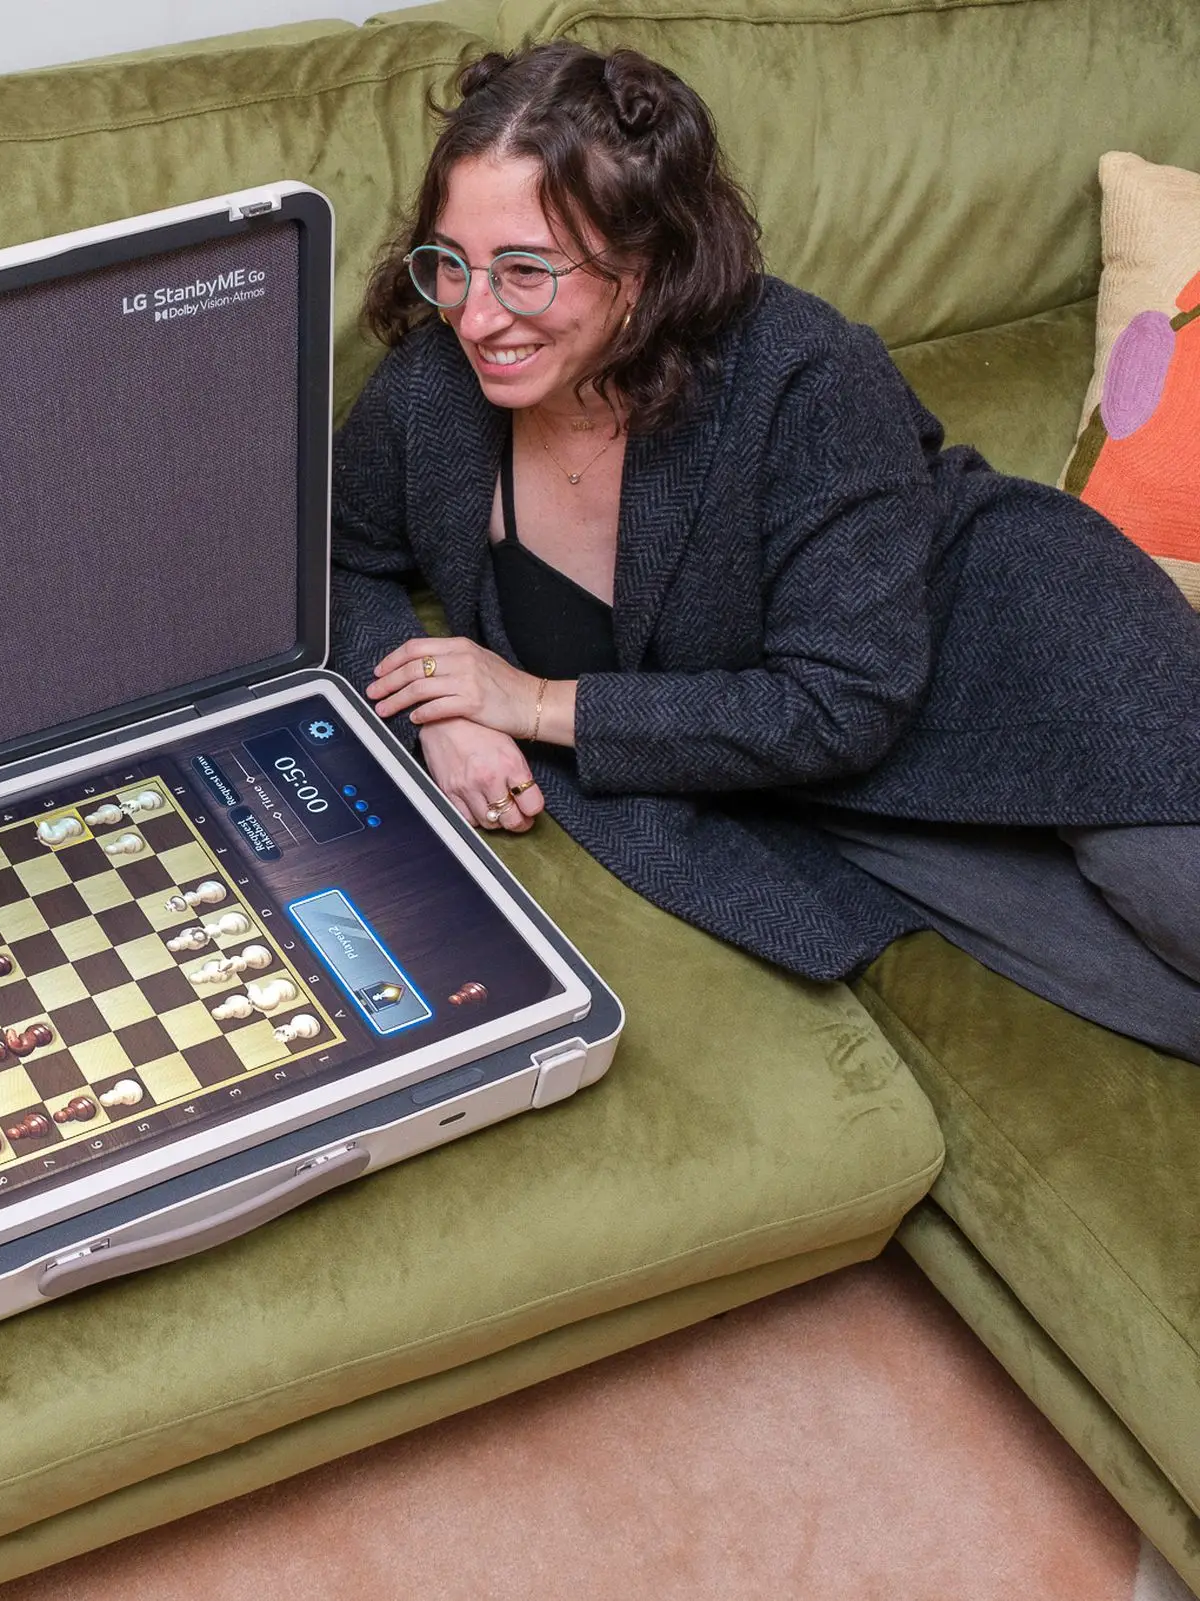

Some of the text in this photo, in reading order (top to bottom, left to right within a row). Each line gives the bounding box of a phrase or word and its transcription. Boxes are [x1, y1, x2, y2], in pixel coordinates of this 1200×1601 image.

[122, 269, 265, 314] LG StanbyME Go
[169, 303, 199, 318] Dolby
[210, 775, 236, 806] Request
[255, 785, 274, 810] Time
[274, 756, 329, 813] 00:50
[4, 814, 13, 822] 4
[43, 800, 54, 809] 3
[85, 786, 94, 795] 2
[237, 819, 263, 852] Request
[247, 814, 275, 850] Takeback
[174, 786, 186, 795] H
[195, 816, 206, 824] G
[239, 876, 249, 885] E
[261, 909, 272, 917] D
[284, 941, 295, 949] C
[308, 975, 320, 984] B
[334, 1009, 346, 1019] A
[328, 925, 358, 960] Player2
[44, 1160, 56, 1168] 7
[91, 1140, 103, 1150] 6
[138, 1123, 150, 1132] 5
[184, 1105, 196, 1114] 4
[230, 1088, 242, 1098] 3
[275, 1071, 286, 1080] 2
